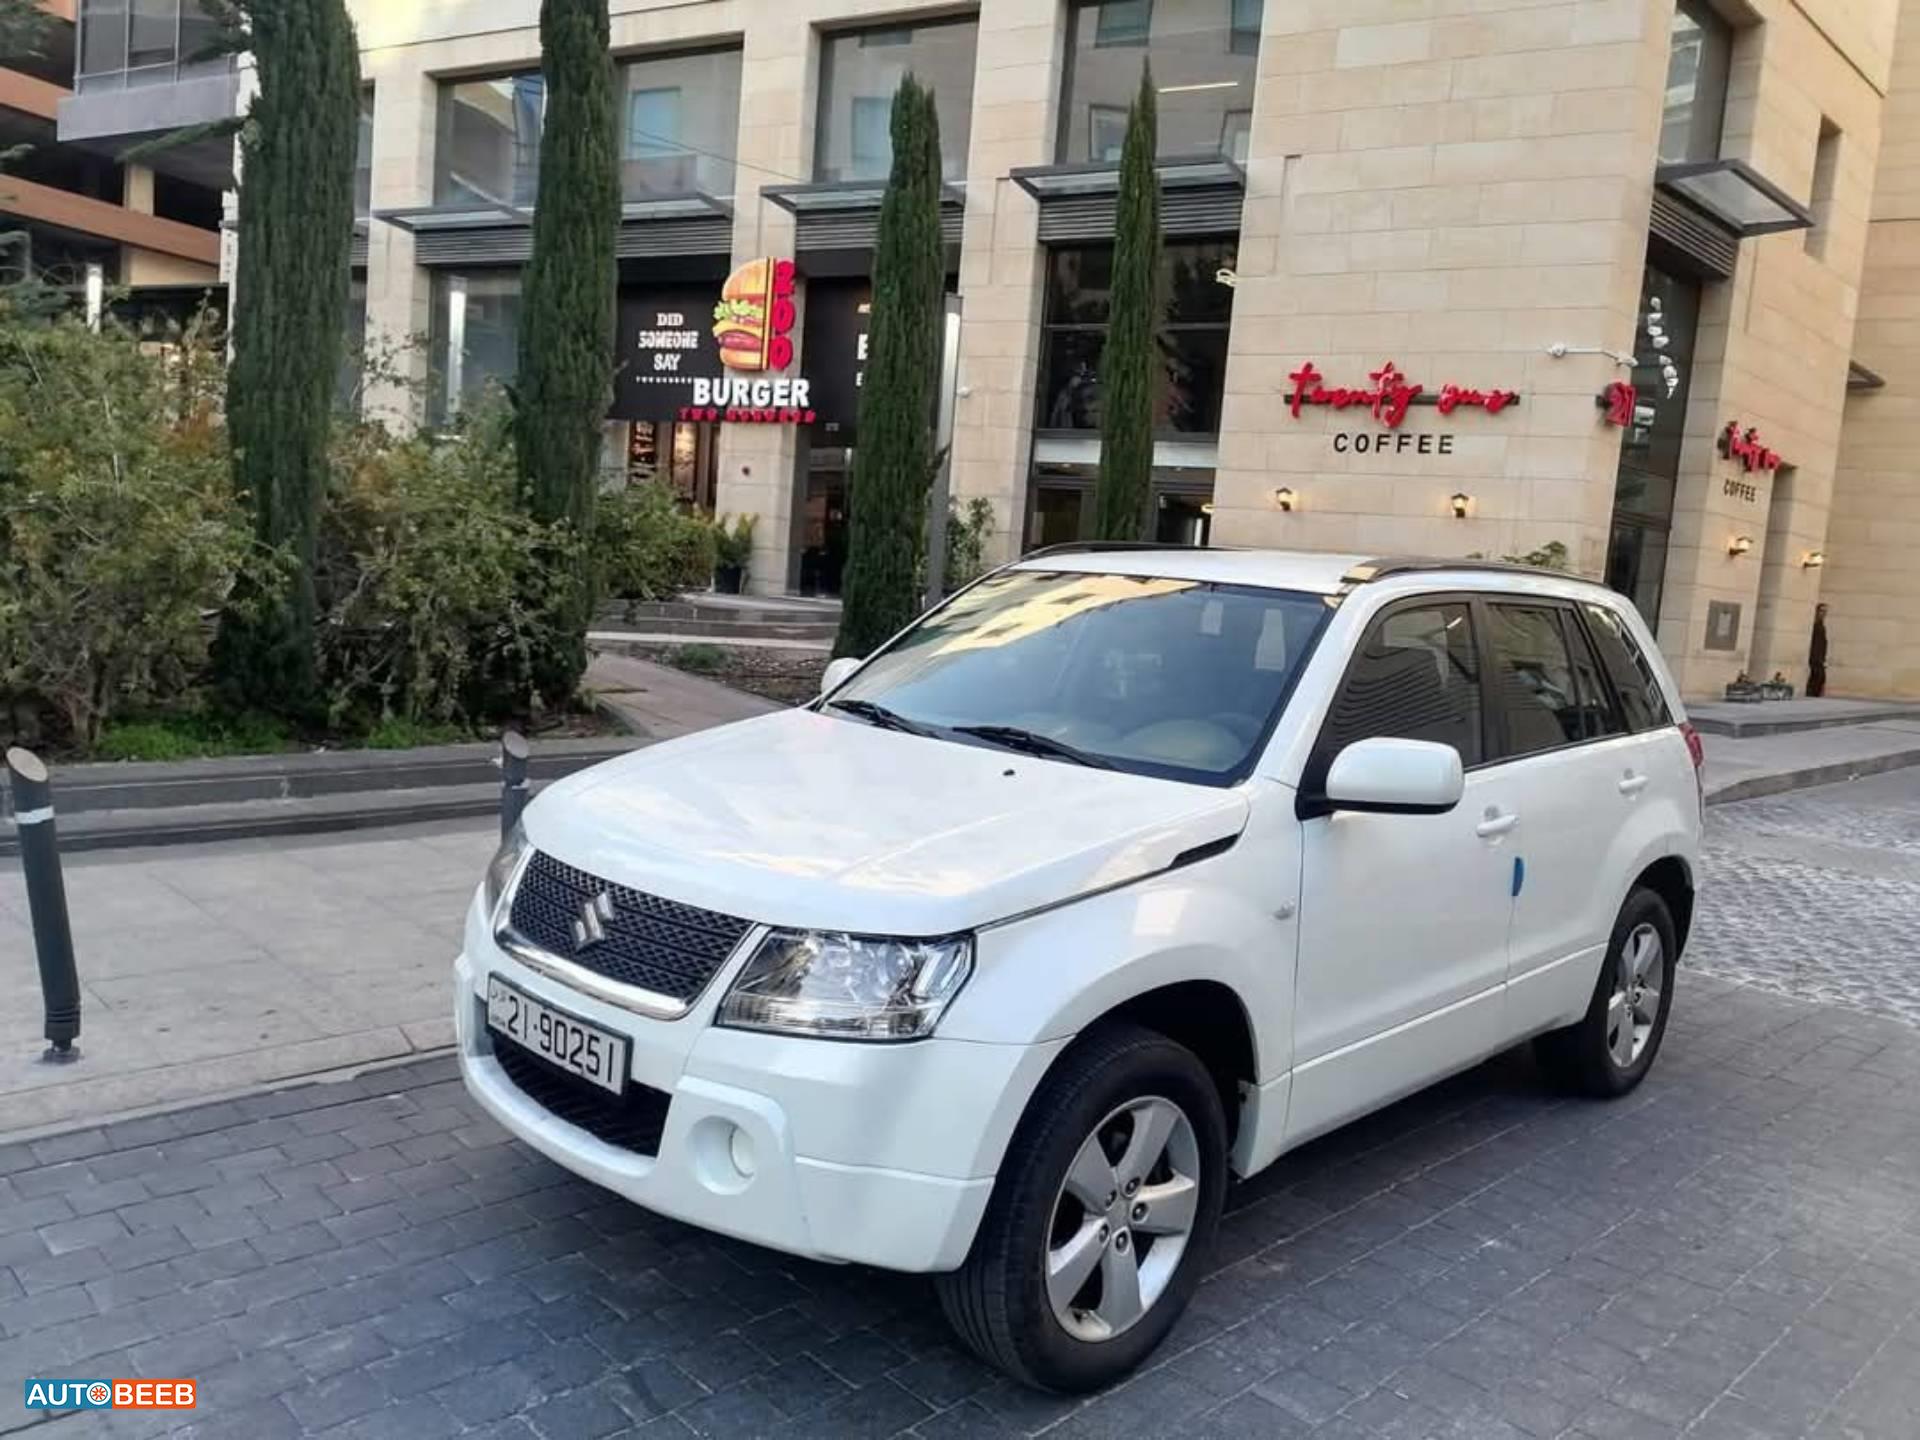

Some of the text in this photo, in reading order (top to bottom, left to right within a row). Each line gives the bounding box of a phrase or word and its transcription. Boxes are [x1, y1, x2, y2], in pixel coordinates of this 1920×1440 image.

[656, 312, 684, 326] DID
[638, 330, 699, 349] SOMEONE
[653, 353, 681, 371] SAY
[692, 377, 811, 408] BURGER
[1333, 432, 1454, 454] COFFEE
[1723, 478, 1756, 502] COFFEE
